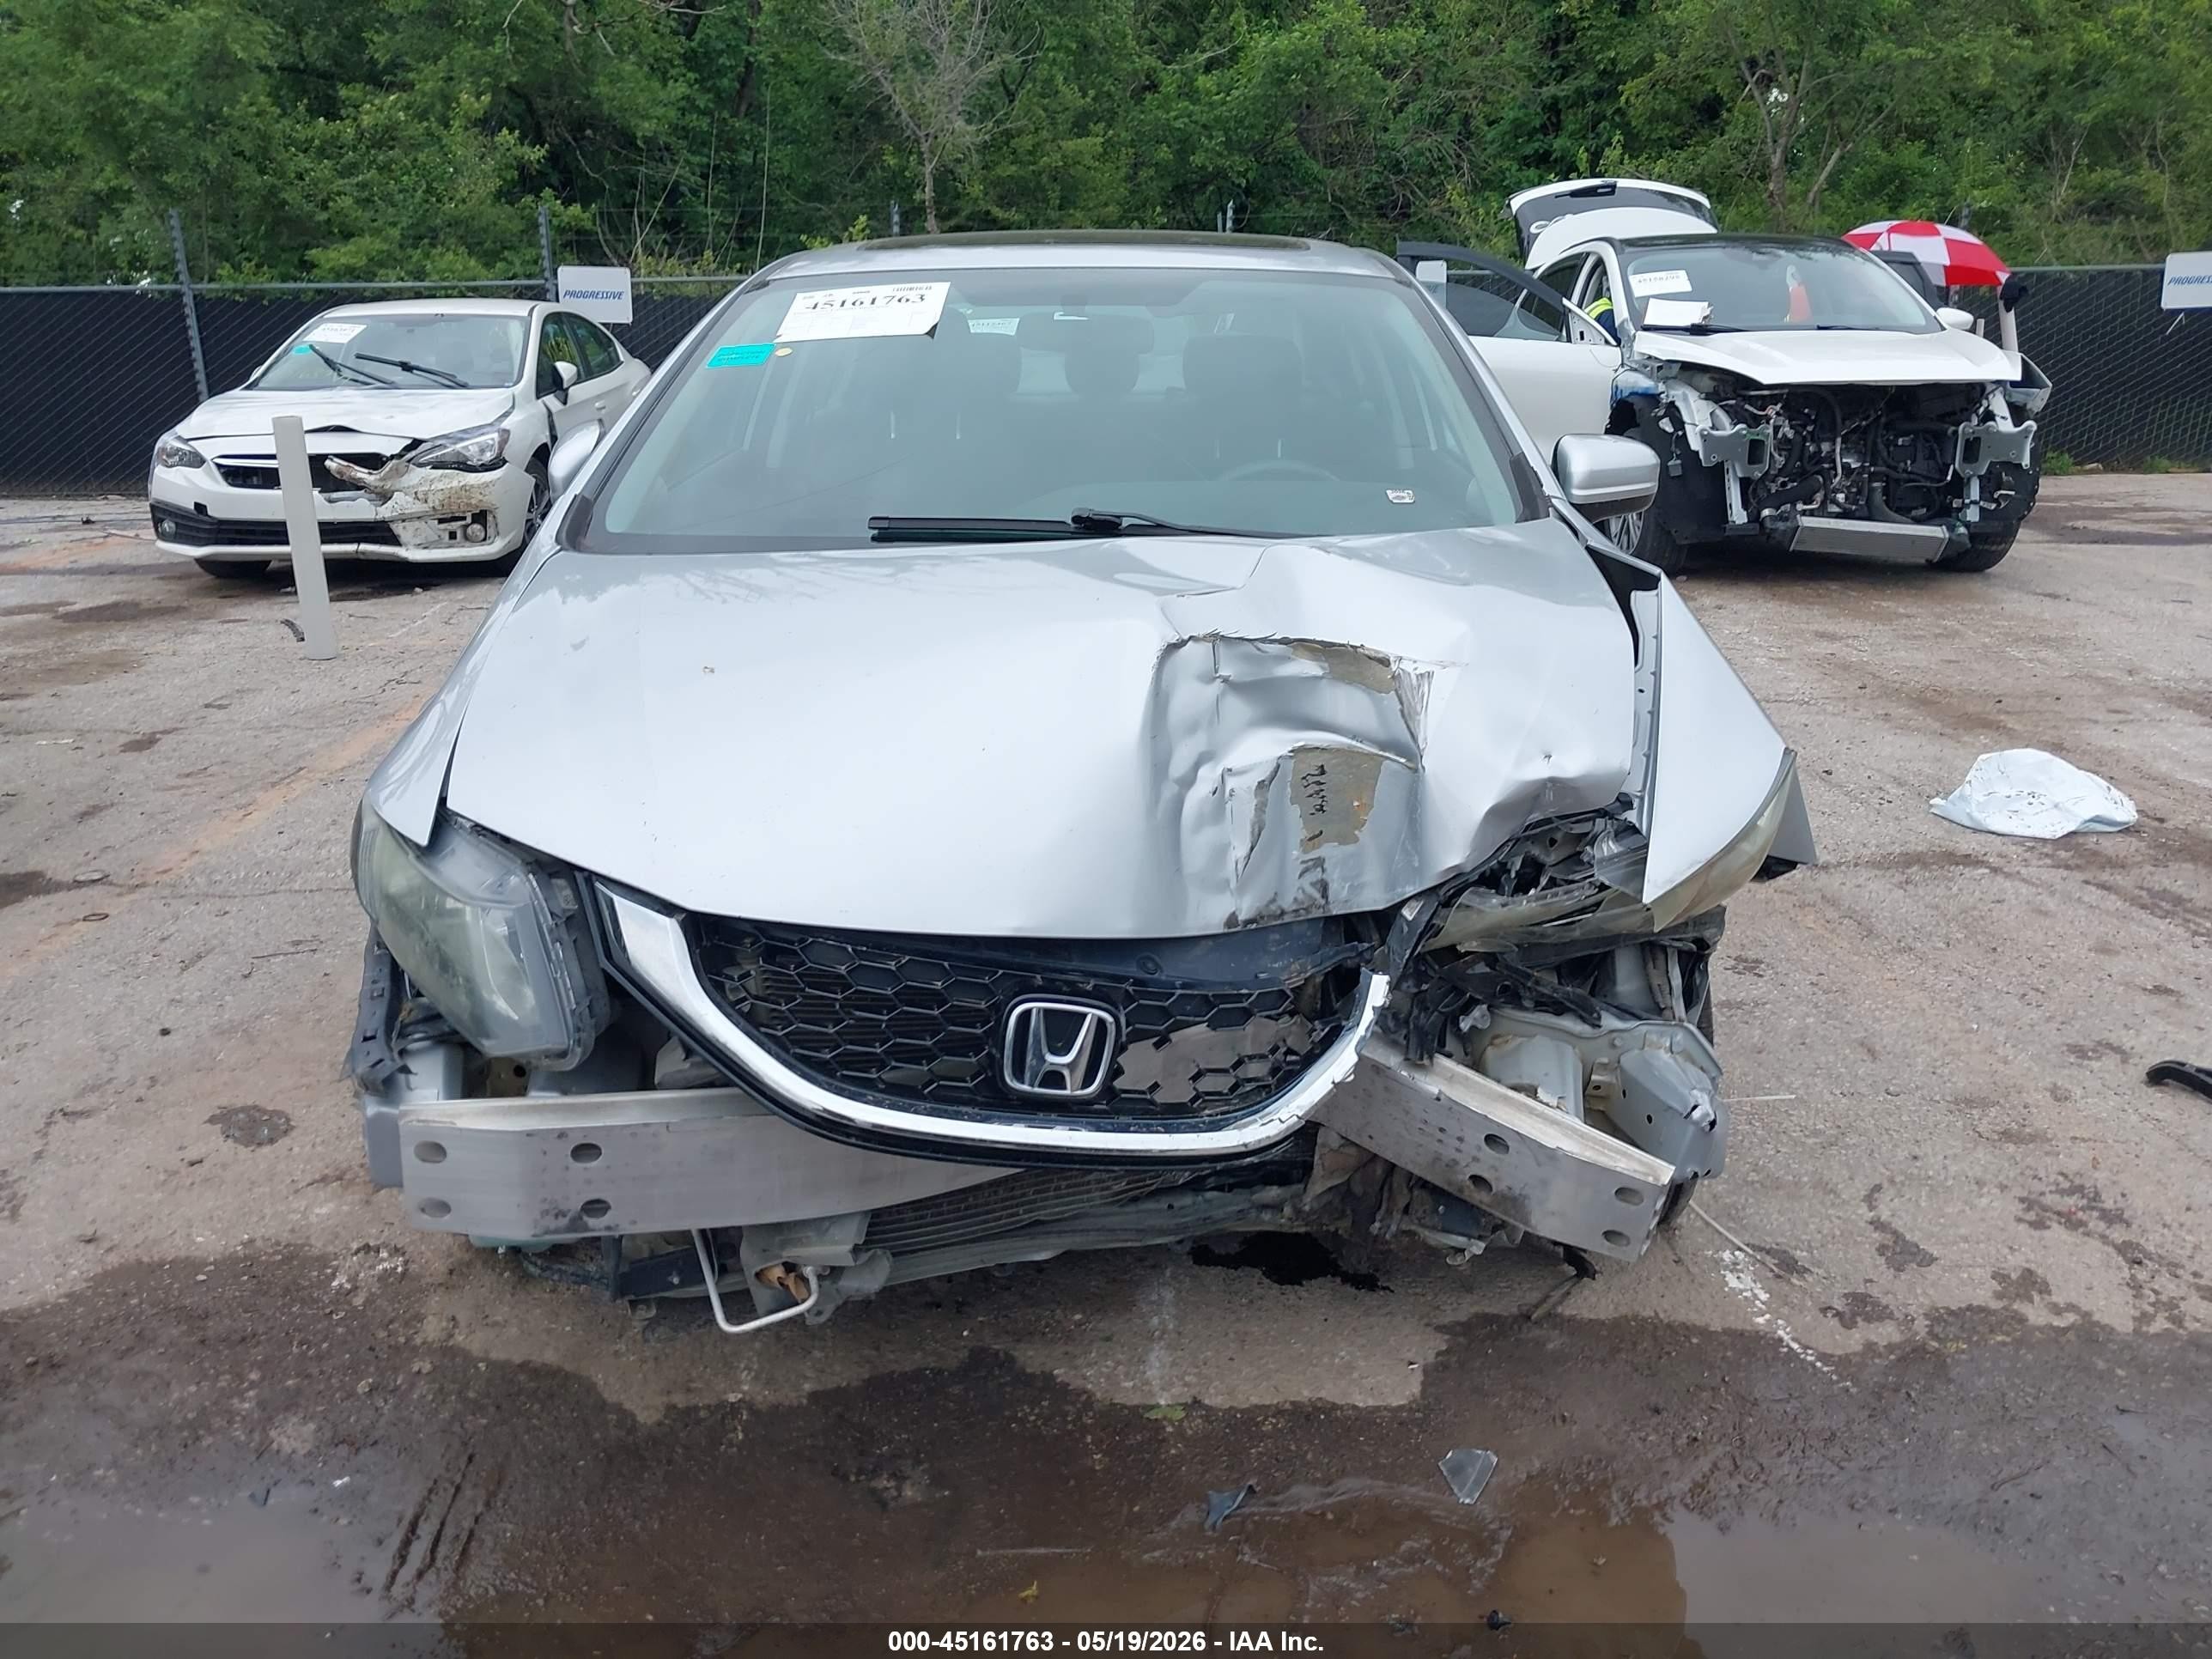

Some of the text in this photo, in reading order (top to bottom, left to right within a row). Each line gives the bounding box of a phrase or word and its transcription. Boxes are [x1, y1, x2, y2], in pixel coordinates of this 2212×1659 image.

[2167, 276, 2212, 286] PROGRES
[563, 289, 624, 301] PROGRESSIVE
[805, 294, 927, 310] 45161763
